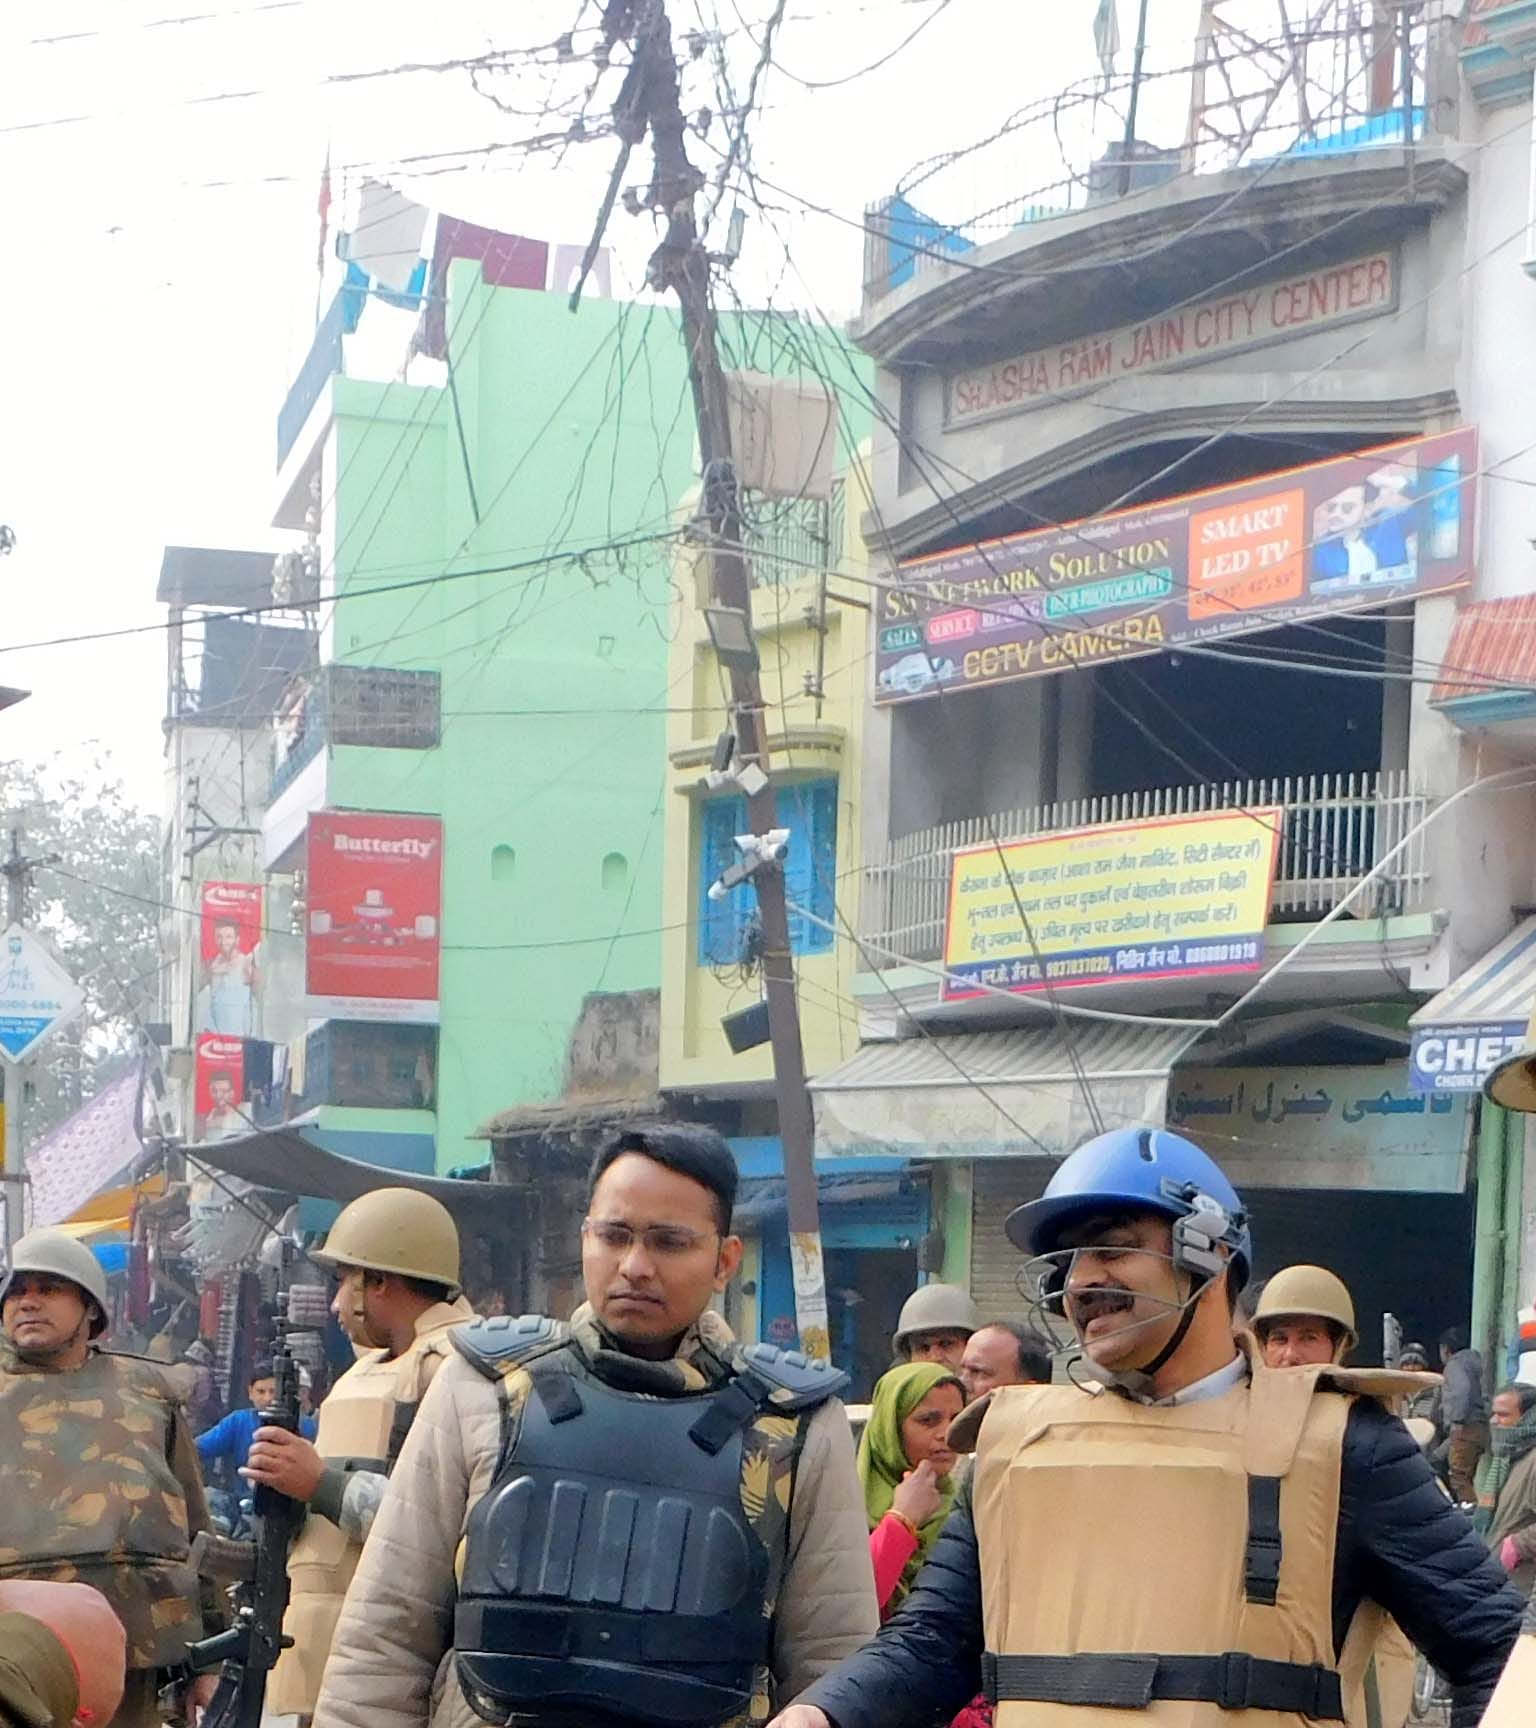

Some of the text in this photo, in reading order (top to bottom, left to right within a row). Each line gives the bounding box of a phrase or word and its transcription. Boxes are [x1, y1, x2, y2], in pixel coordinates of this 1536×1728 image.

[1059, 344, 1112, 390] RAM
[1121, 318, 1185, 370] JAIN
[1194, 298, 1262, 348] CITY
[1269, 259, 1390, 328] CENTER
[1200, 503, 1289, 544] SMART
[1200, 539, 1289, 580] LED TV
[963, 613, 1165, 679] CCTV CAMERA
[333, 833, 434, 860] Butterfly
